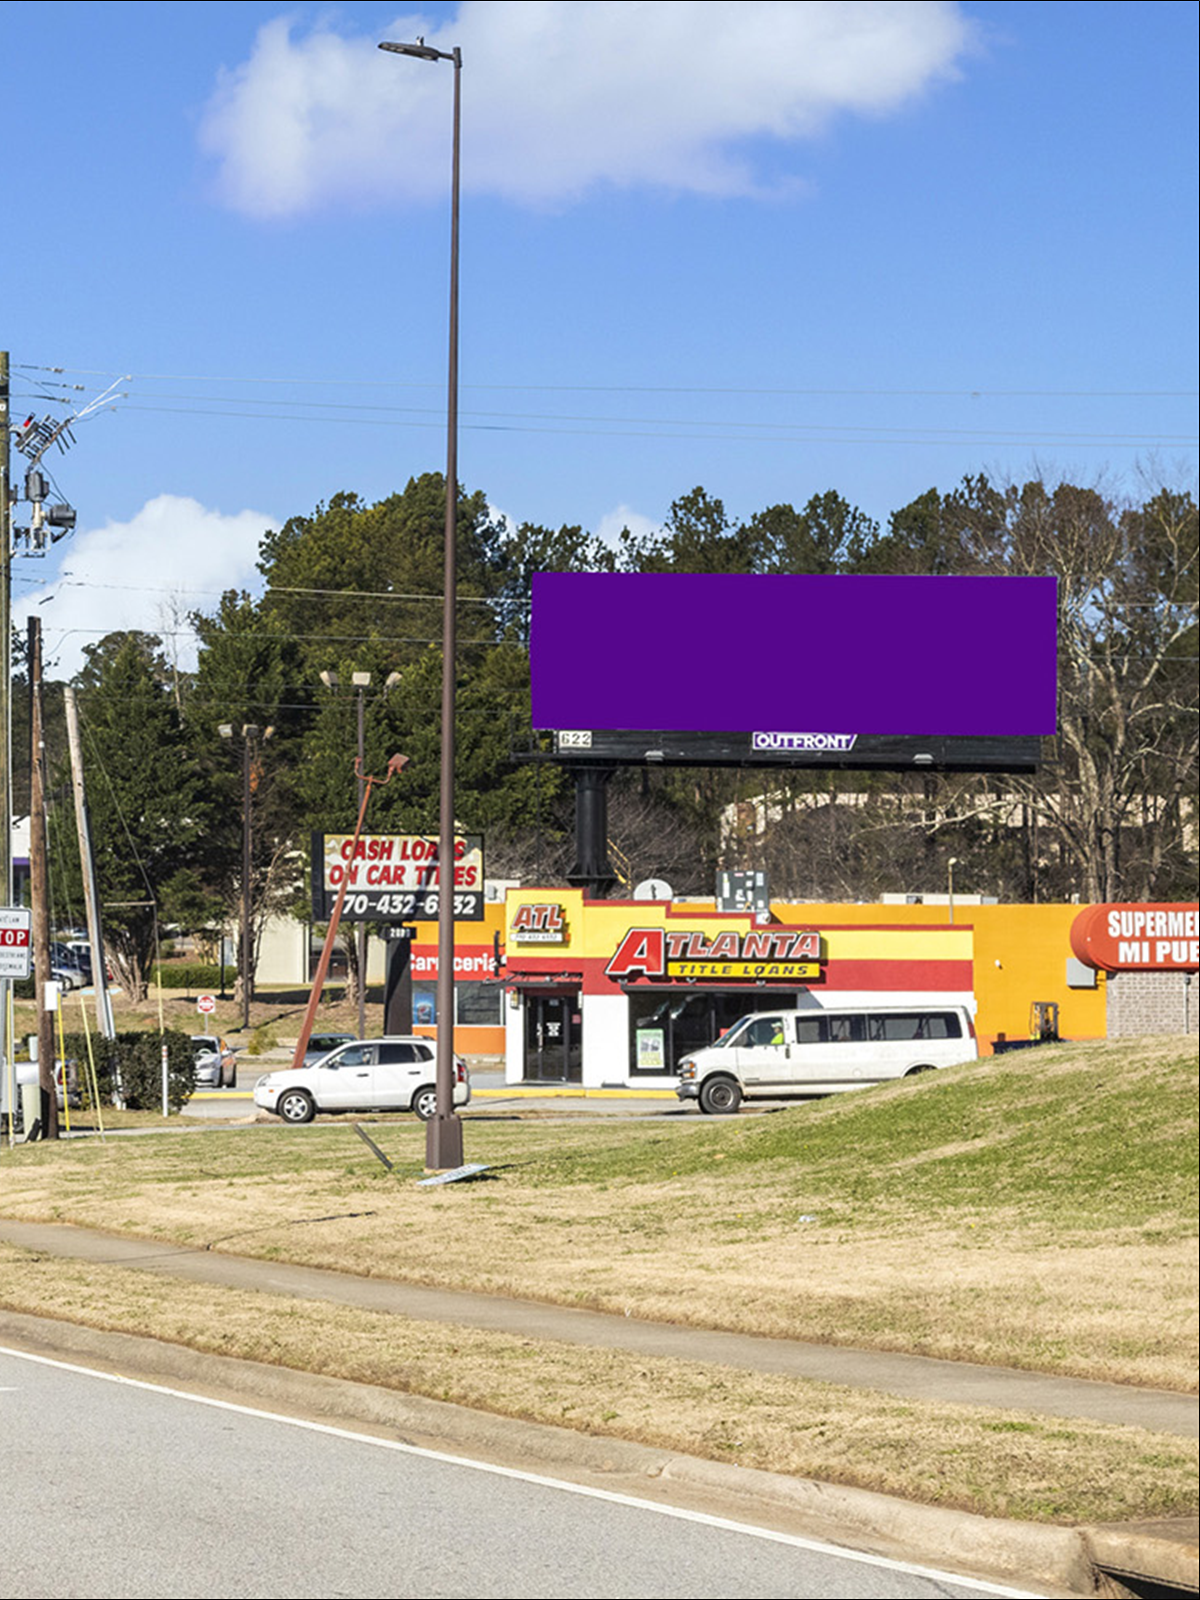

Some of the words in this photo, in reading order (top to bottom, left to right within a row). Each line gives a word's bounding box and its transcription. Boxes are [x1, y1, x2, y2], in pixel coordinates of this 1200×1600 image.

[561, 733, 591, 745] 622
[757, 734, 851, 748] OUTFRONT
[341, 839, 393, 861] CASH
[401, 840, 466, 861] LOAS
[329, 865, 359, 885] ON
[366, 865, 406, 885] CAR
[511, 904, 562, 929] ATL
[605, 927, 820, 975] ATLANTA
[1119, 941, 1150, 963] MI
[678, 964, 732, 975] TITLE
[742, 964, 809, 976] LOANS
